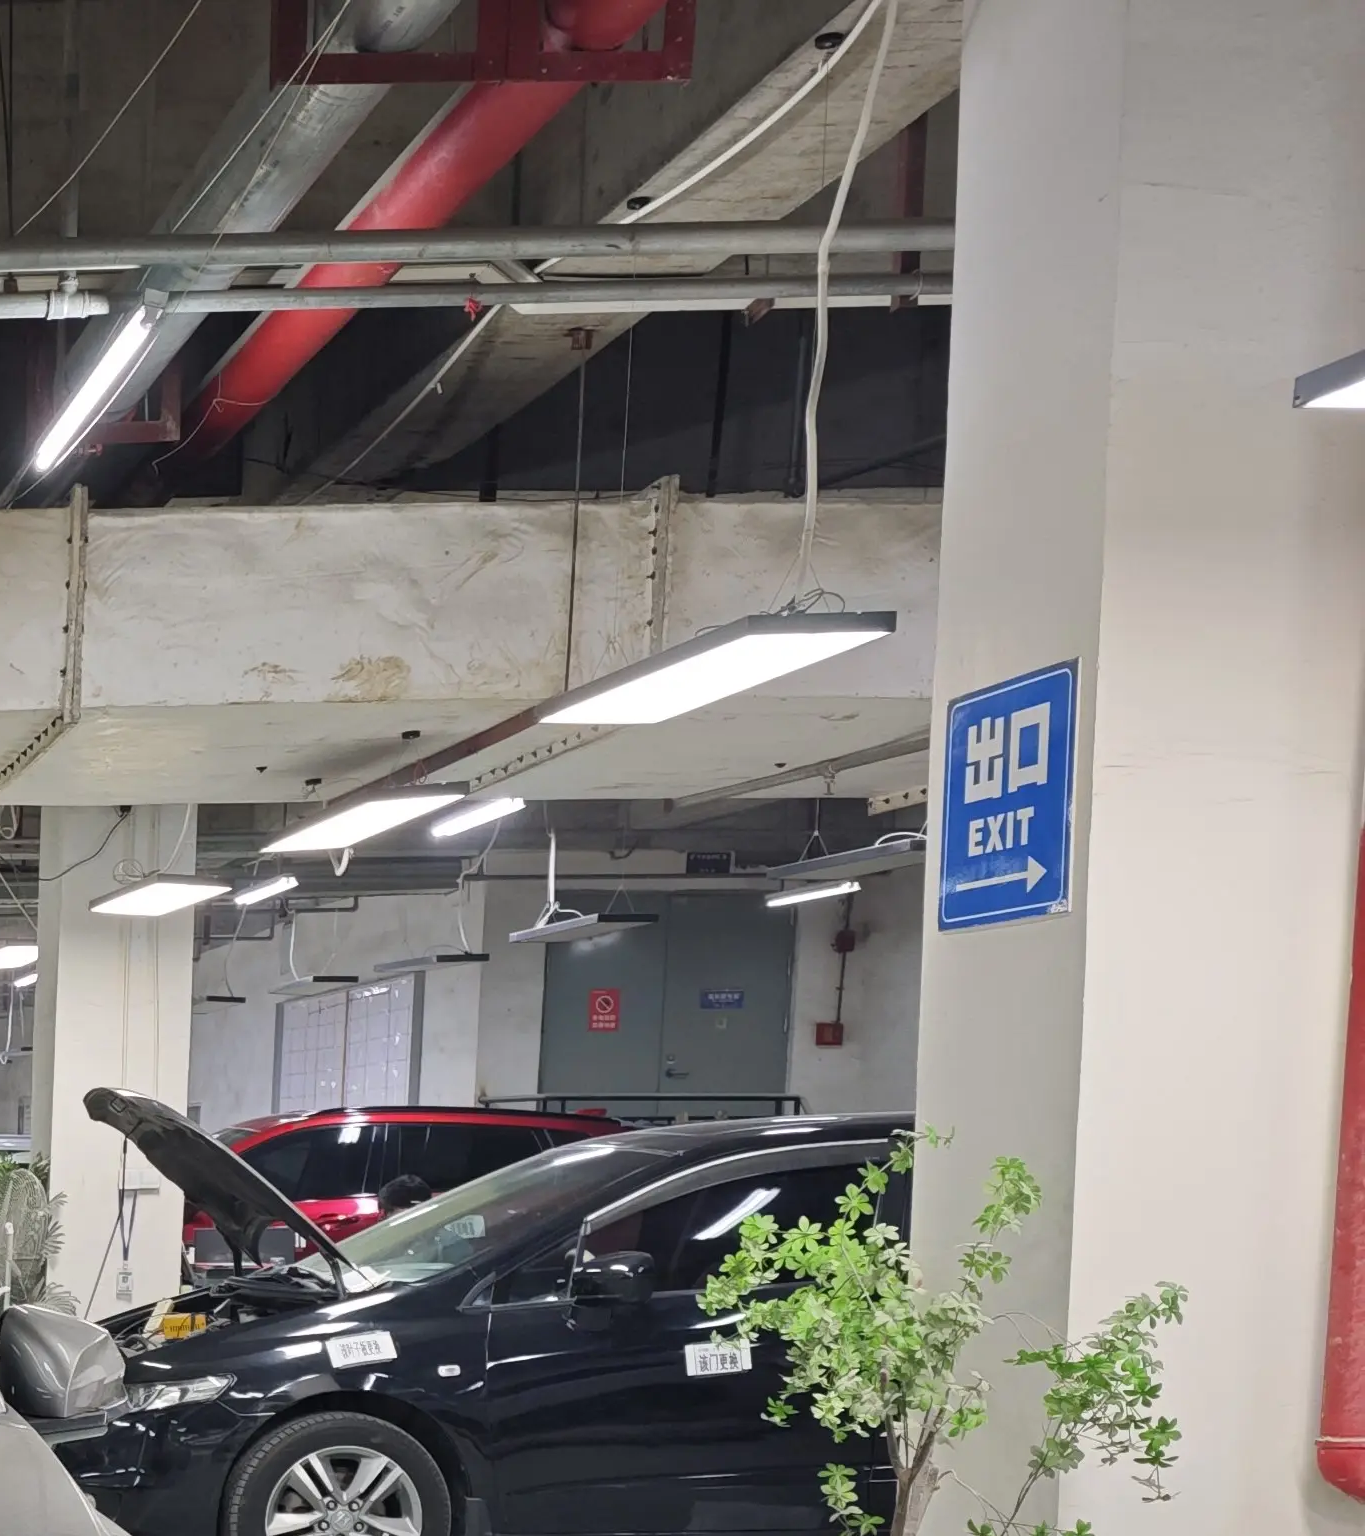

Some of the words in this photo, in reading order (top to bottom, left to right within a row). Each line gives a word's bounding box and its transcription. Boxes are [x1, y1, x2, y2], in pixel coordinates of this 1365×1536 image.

[964, 702, 1051, 804] 出口
[968, 806, 1035, 857] EXIT
[699, 1351, 739, 1373] 该门更换
